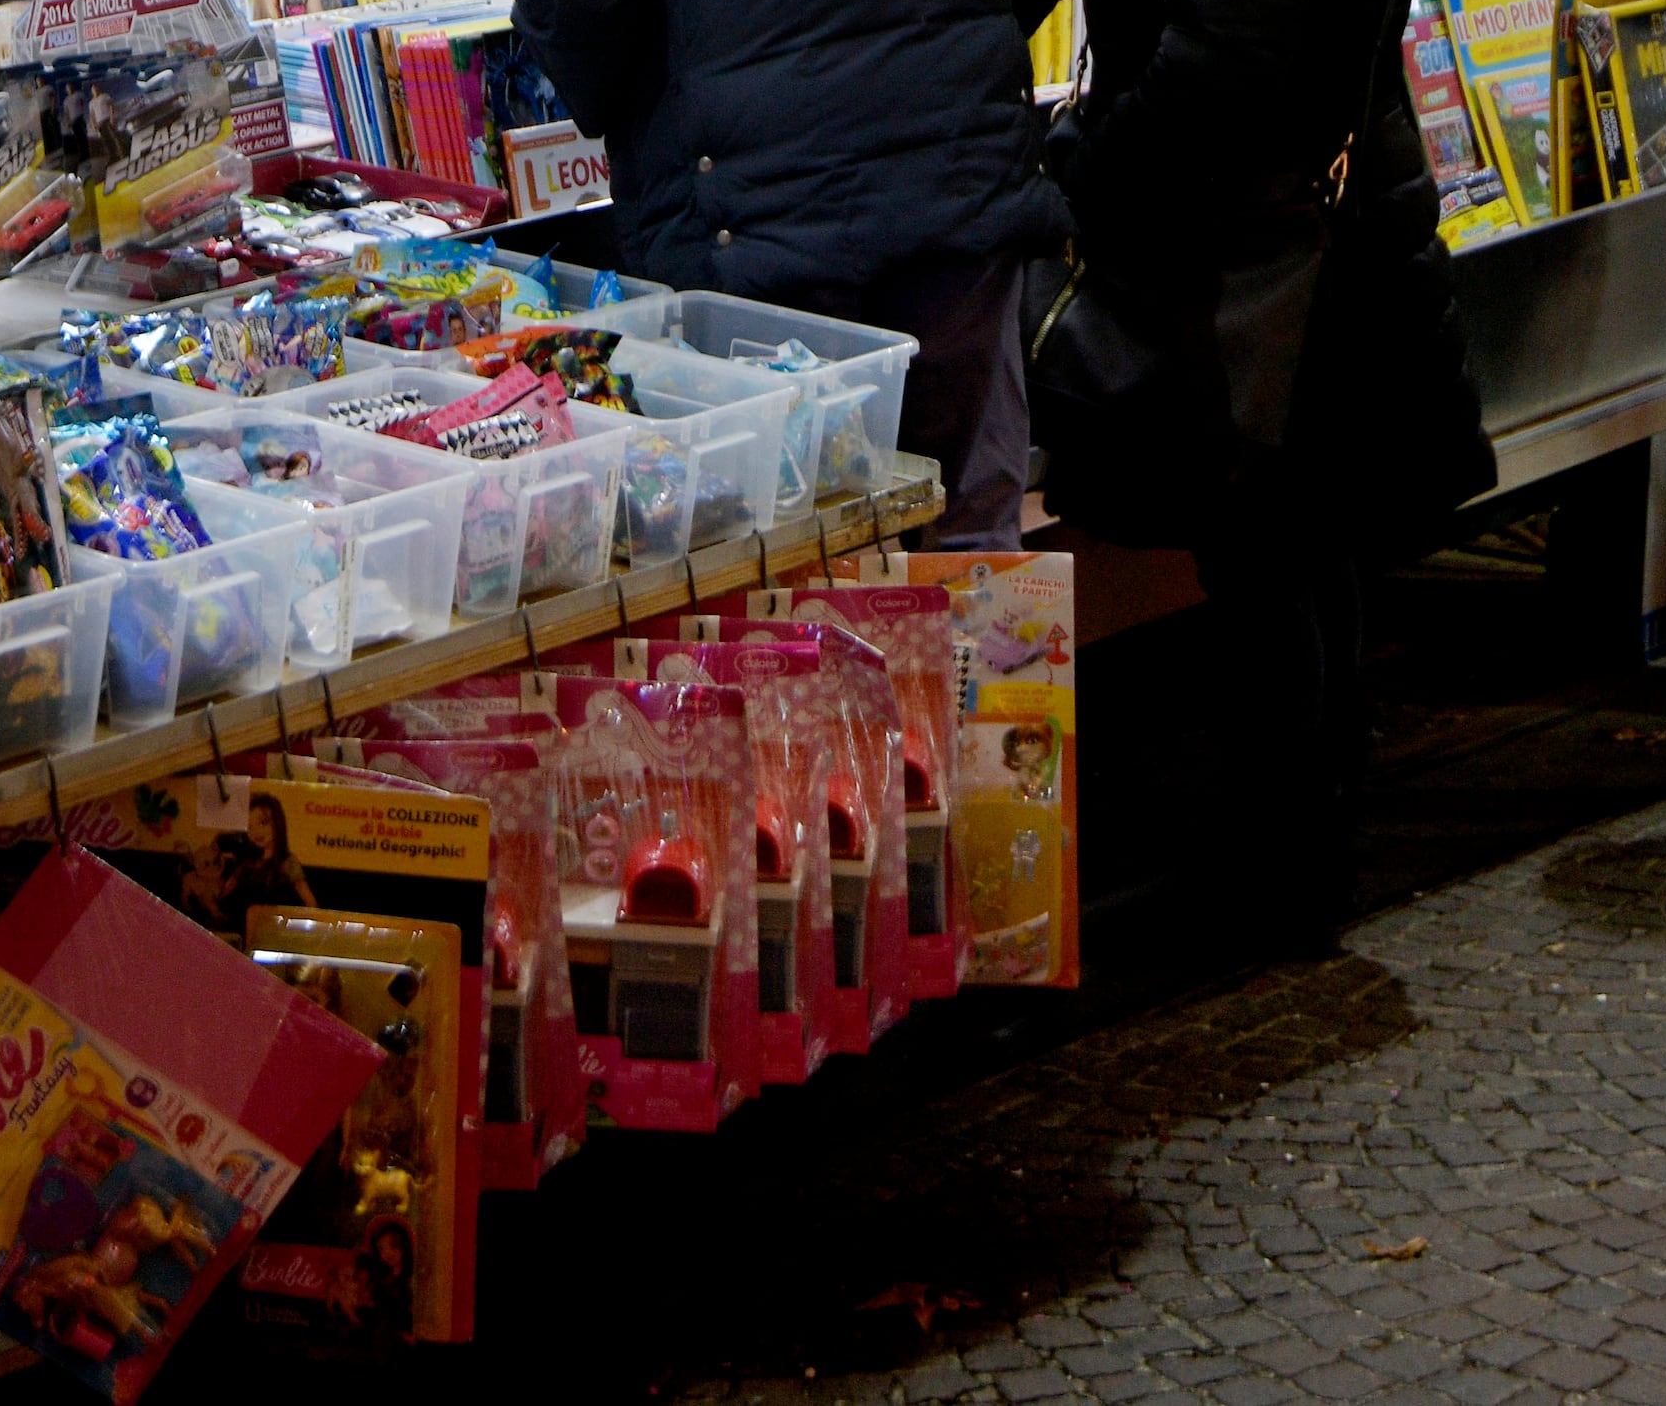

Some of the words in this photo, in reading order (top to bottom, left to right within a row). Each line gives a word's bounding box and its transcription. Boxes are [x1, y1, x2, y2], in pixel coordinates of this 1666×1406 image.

[43, 8, 69, 26] 2014
[1455, 12, 1471, 42] IL
[1473, 6, 1507, 37] MIO
[256, 108, 281, 121] METAL
[130, 115, 199, 164] FAST
[240, 120, 283, 138] OPENABLE
[254, 133, 284, 148] ACTION
[104, 120, 221, 194] FURIOUS
[525, 158, 551, 211] L
[1022, 588, 1060, 599] PARTE!
[1023, 577, 1066, 590] CARICHI
[305, 801, 368, 819] Continua
[370, 807, 383, 820] la
[386, 808, 479, 827] COLLEZIONE
[360, 824, 371, 835] di
[381, 825, 422, 839] Barbie
[316, 834, 377, 851] National
[380, 839, 465, 859] Geographic!
[7, 1054, 79, 1134] Fantasy
